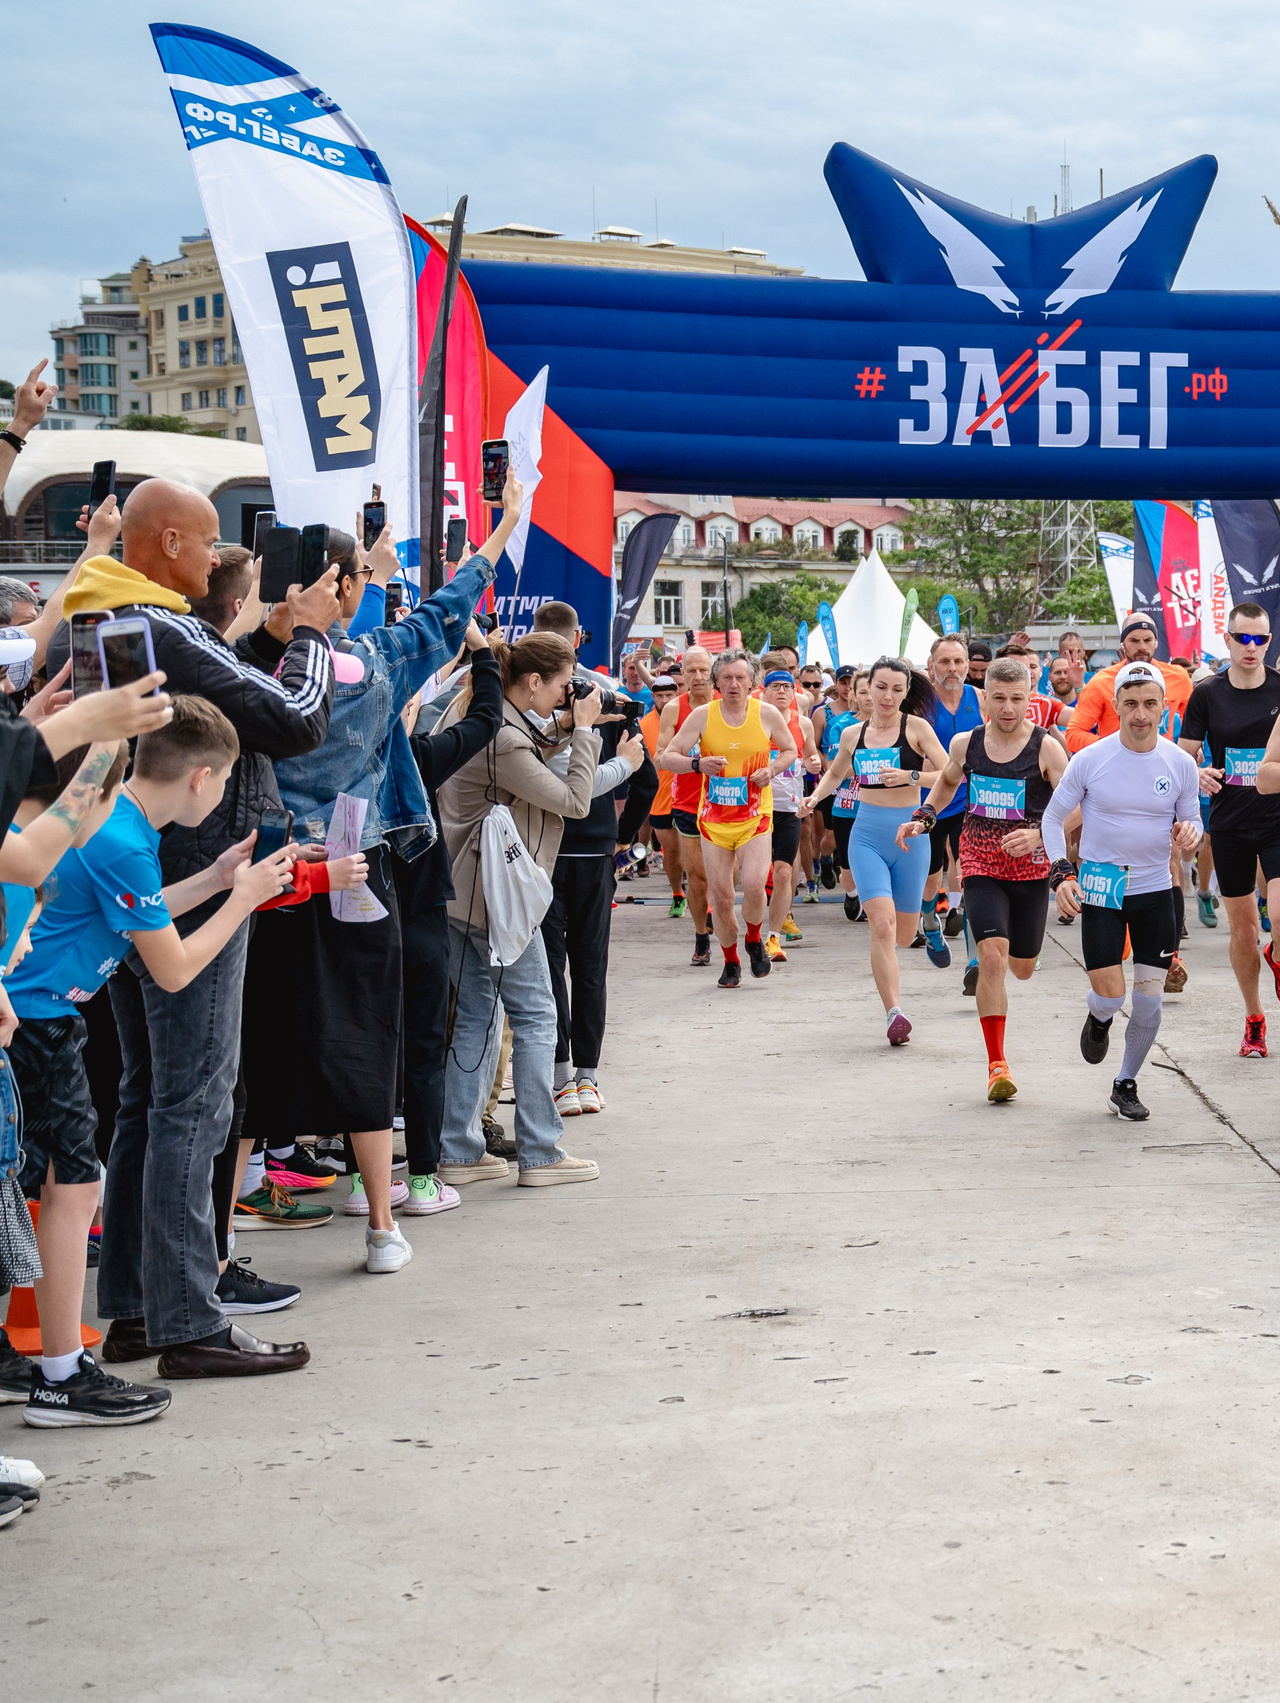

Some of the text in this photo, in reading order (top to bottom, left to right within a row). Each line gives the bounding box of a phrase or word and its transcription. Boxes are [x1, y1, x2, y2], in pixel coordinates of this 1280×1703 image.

[866, 774, 881, 785] 10K
[1241, 775, 1257, 786] 10K
[714, 785, 741, 797] 40076
[978, 789, 1015, 807] 30095
[985, 806, 1007, 819] 10KM
[1081, 873, 1112, 894] 40151
[267, 1159, 287, 1171] HOKA
[33, 1388, 69, 1405] HOKA
